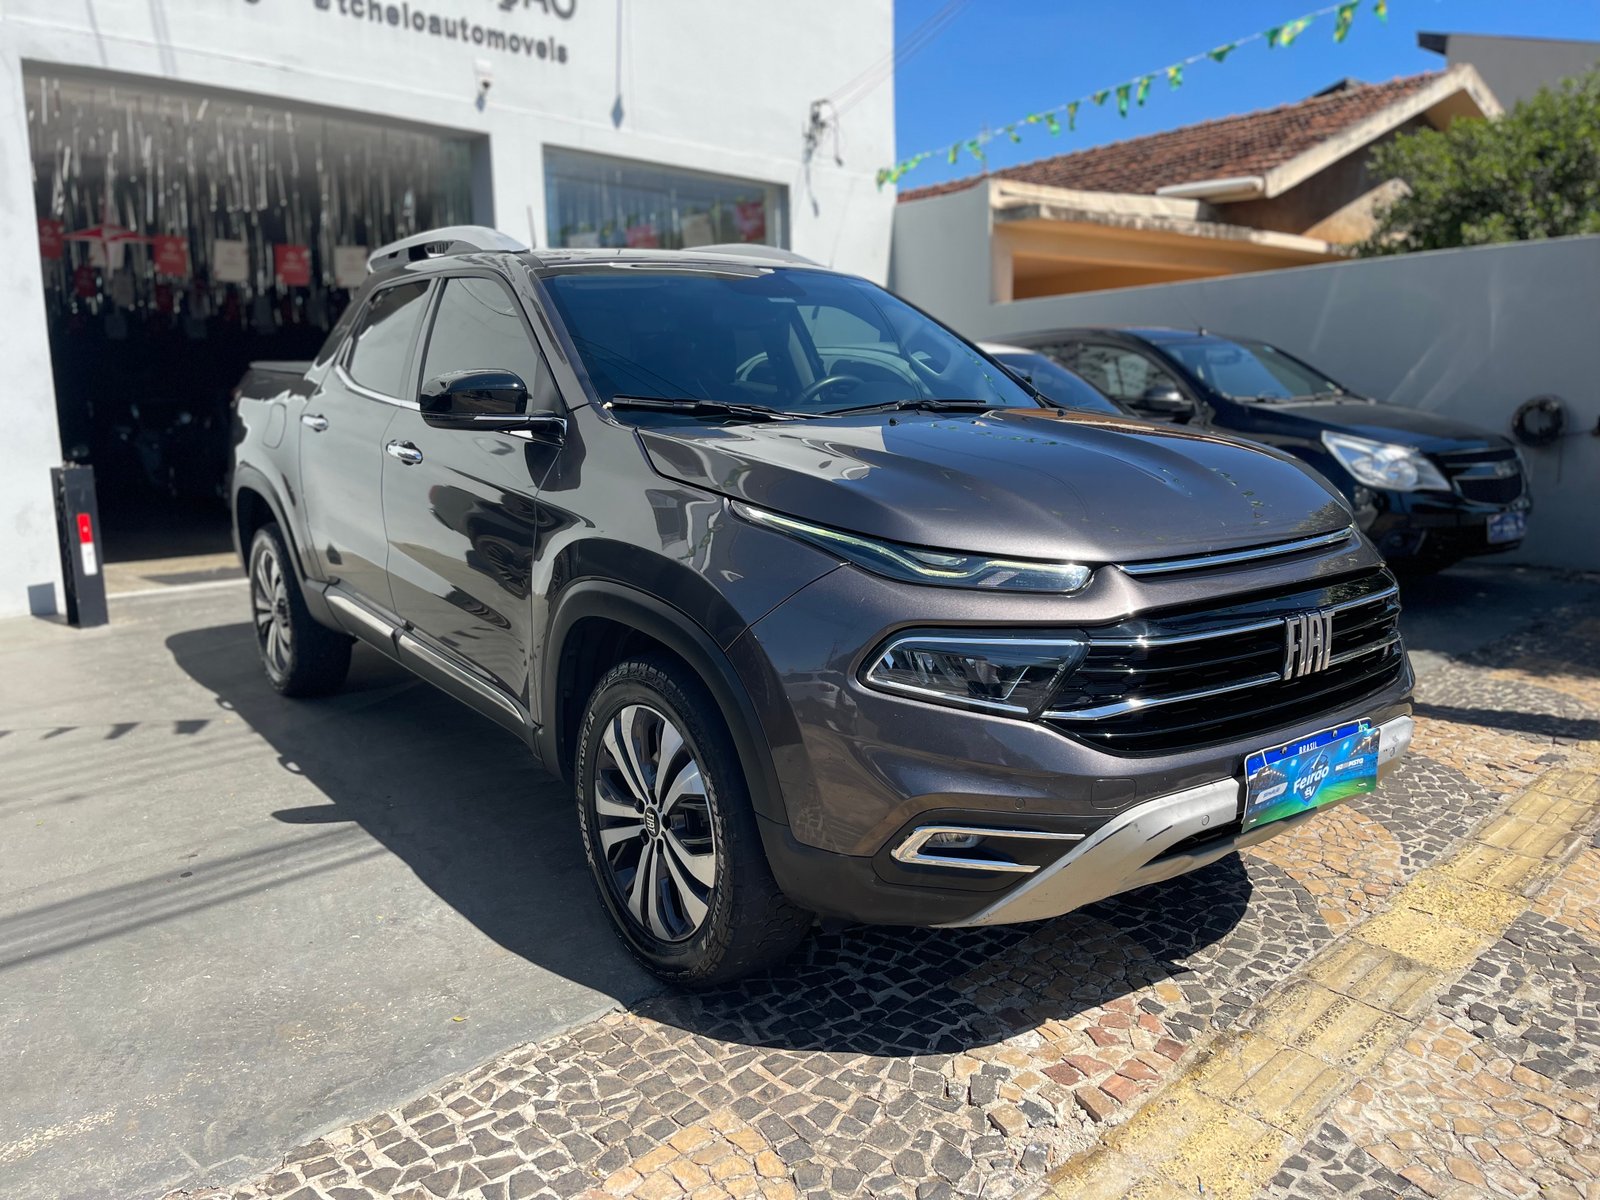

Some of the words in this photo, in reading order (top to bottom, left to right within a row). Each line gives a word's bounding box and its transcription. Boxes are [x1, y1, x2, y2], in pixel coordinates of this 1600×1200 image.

[1284, 611, 1336, 681] FIAT
[1298, 741, 1318, 755] BRASIL
[1293, 764, 1330, 795] Feirão
[646, 811, 656, 835] FIAT
